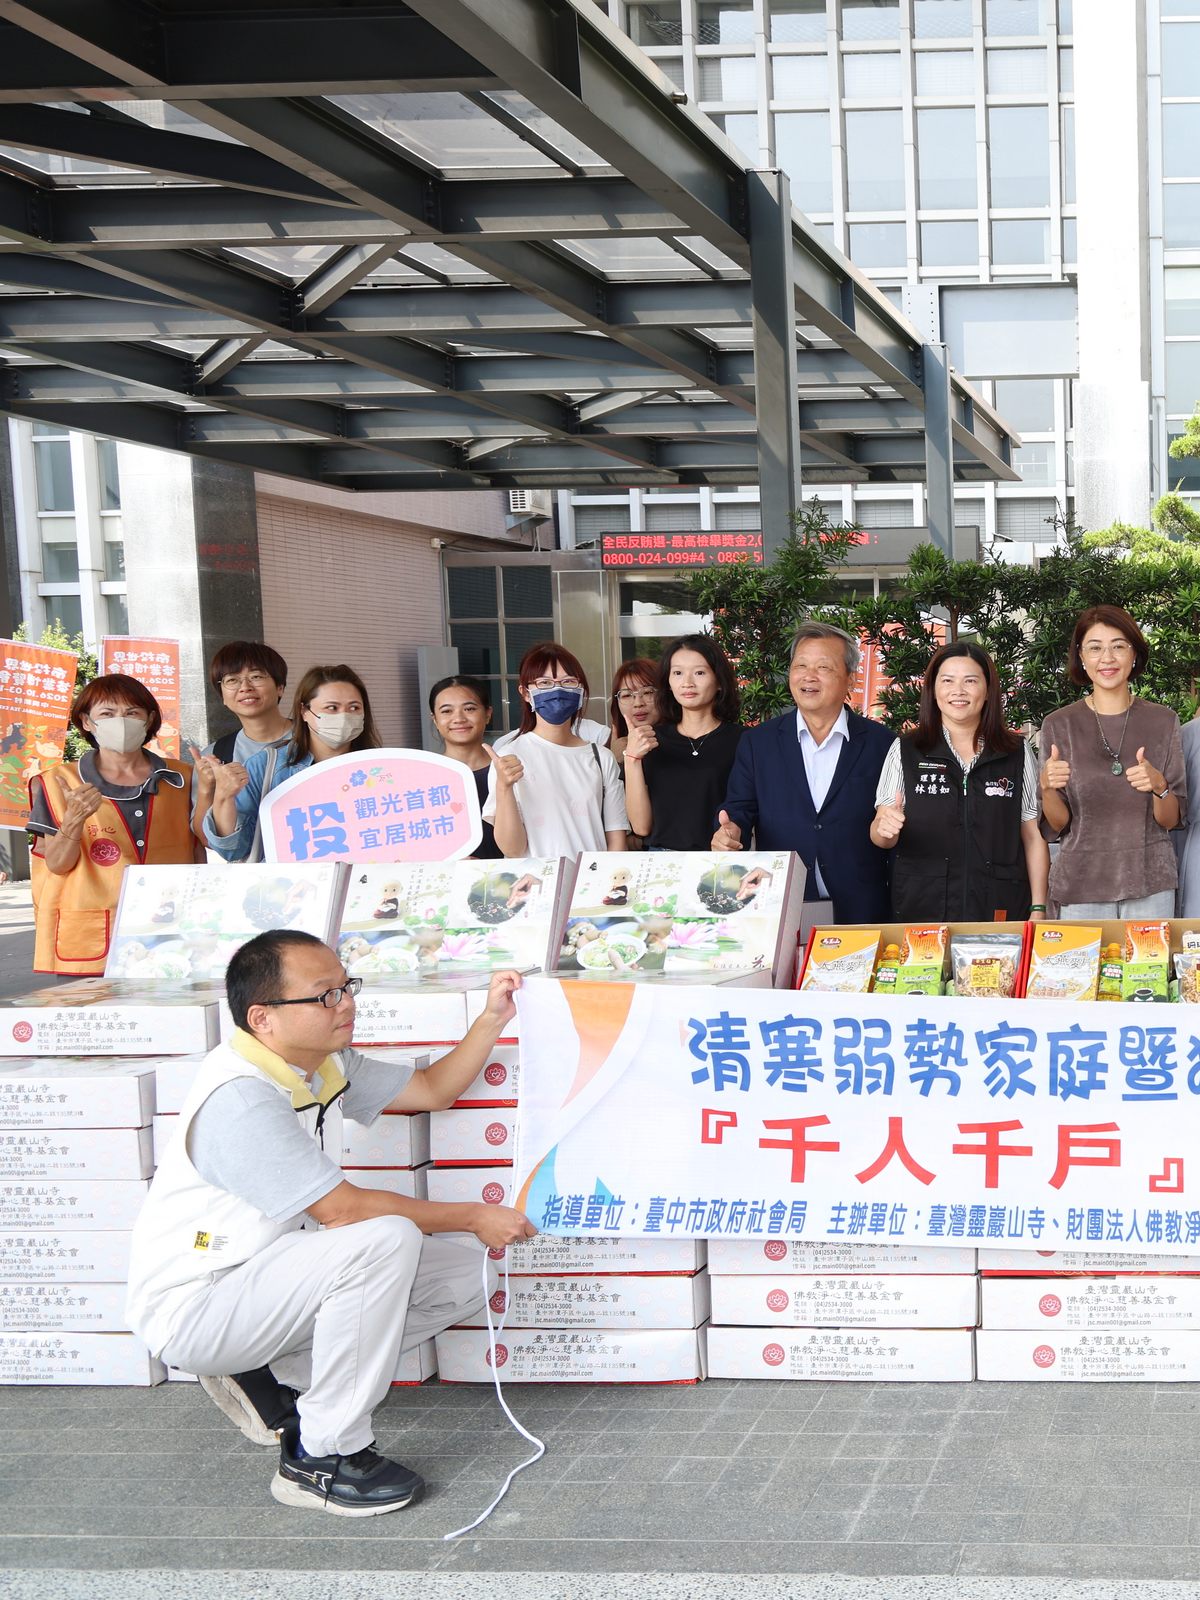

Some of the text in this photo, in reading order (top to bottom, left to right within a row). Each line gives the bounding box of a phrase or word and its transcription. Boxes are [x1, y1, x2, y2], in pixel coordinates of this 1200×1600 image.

[354, 785, 451, 820] 觀光首都
[286, 802, 350, 861] 投
[359, 815, 455, 850] 宜居城市
[701, 1108, 1184, 1193] 『千人千戶』
[541, 1196, 807, 1234] 指導單位：臺中市政府社會局
